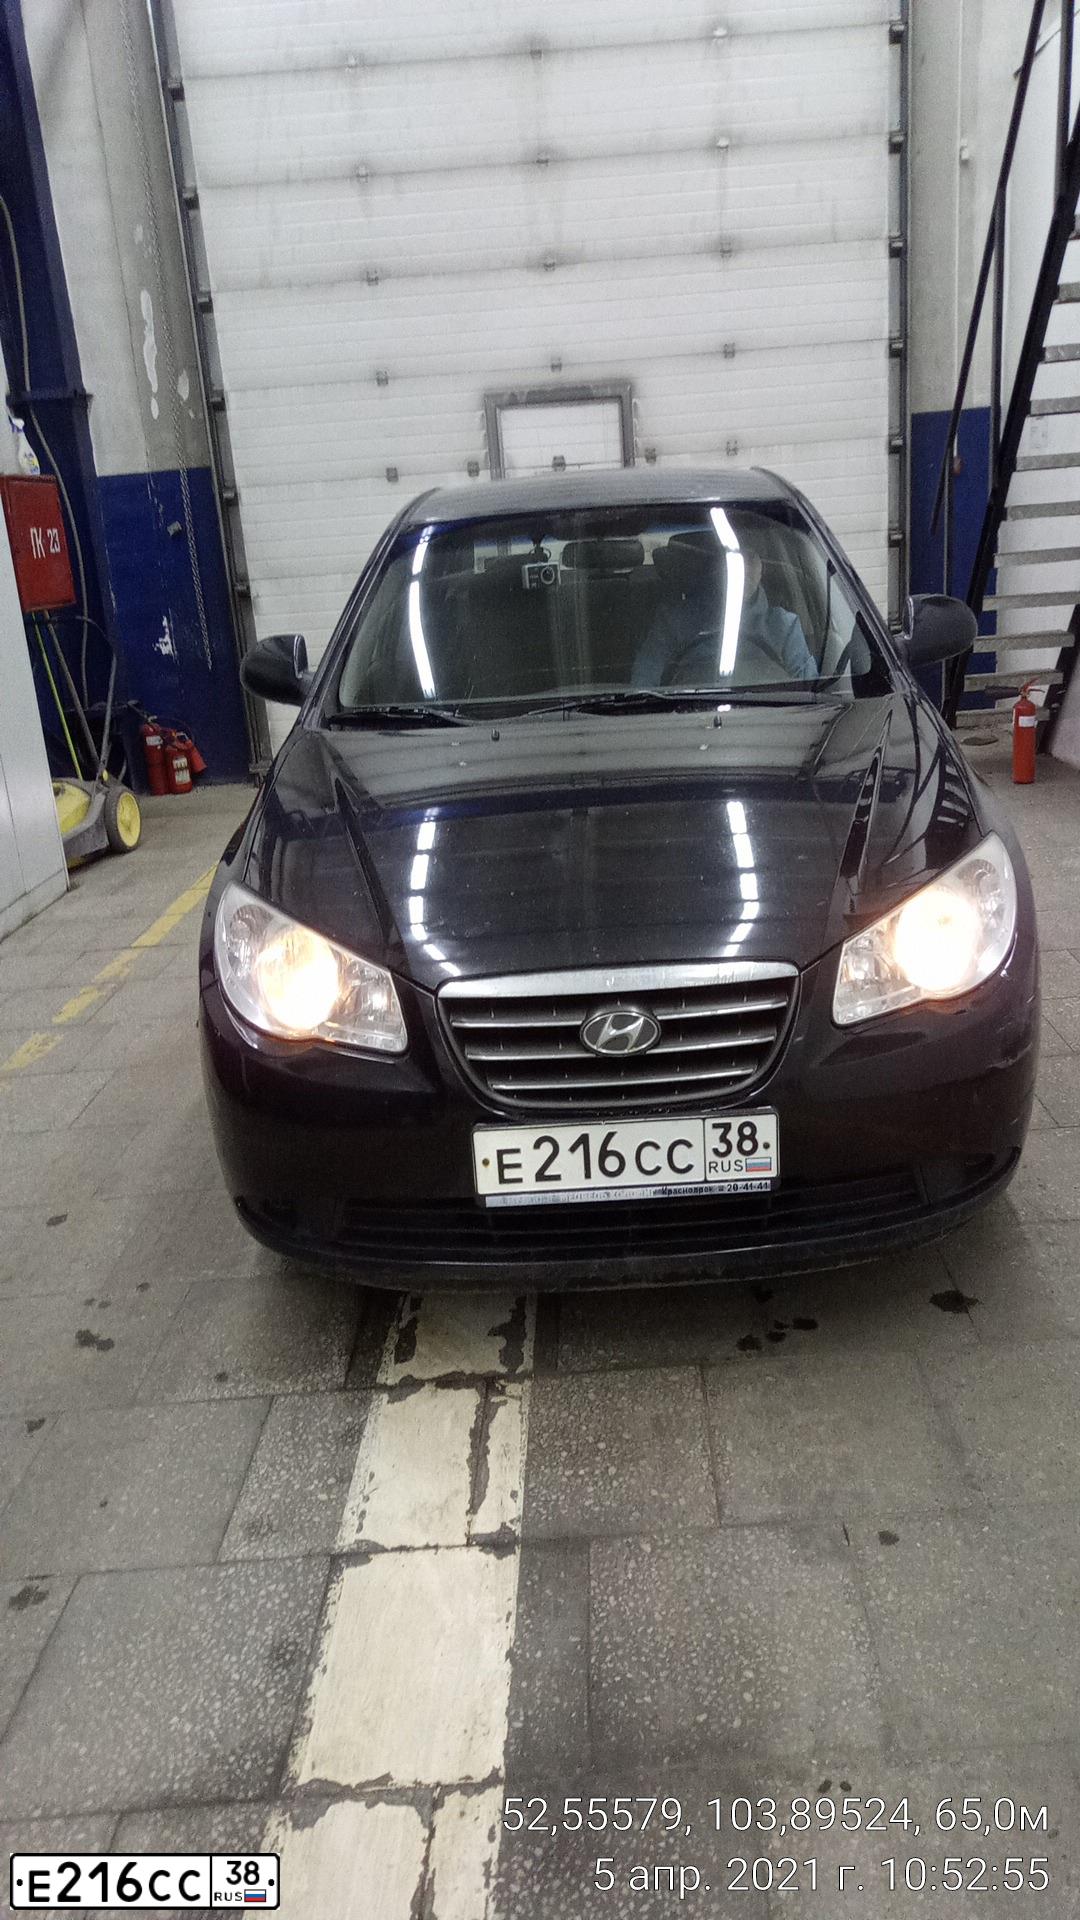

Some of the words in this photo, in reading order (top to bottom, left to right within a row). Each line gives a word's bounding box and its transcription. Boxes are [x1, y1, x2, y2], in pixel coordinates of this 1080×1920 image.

[30, 527, 46, 559] ПК
[47, 528, 61, 554] 23
[495, 1131, 694, 1185] Е216СС
[711, 1121, 757, 1157] 38
[708, 1158, 743, 1173] RUS
[727, 1181, 769, 1192] 20-41-41
